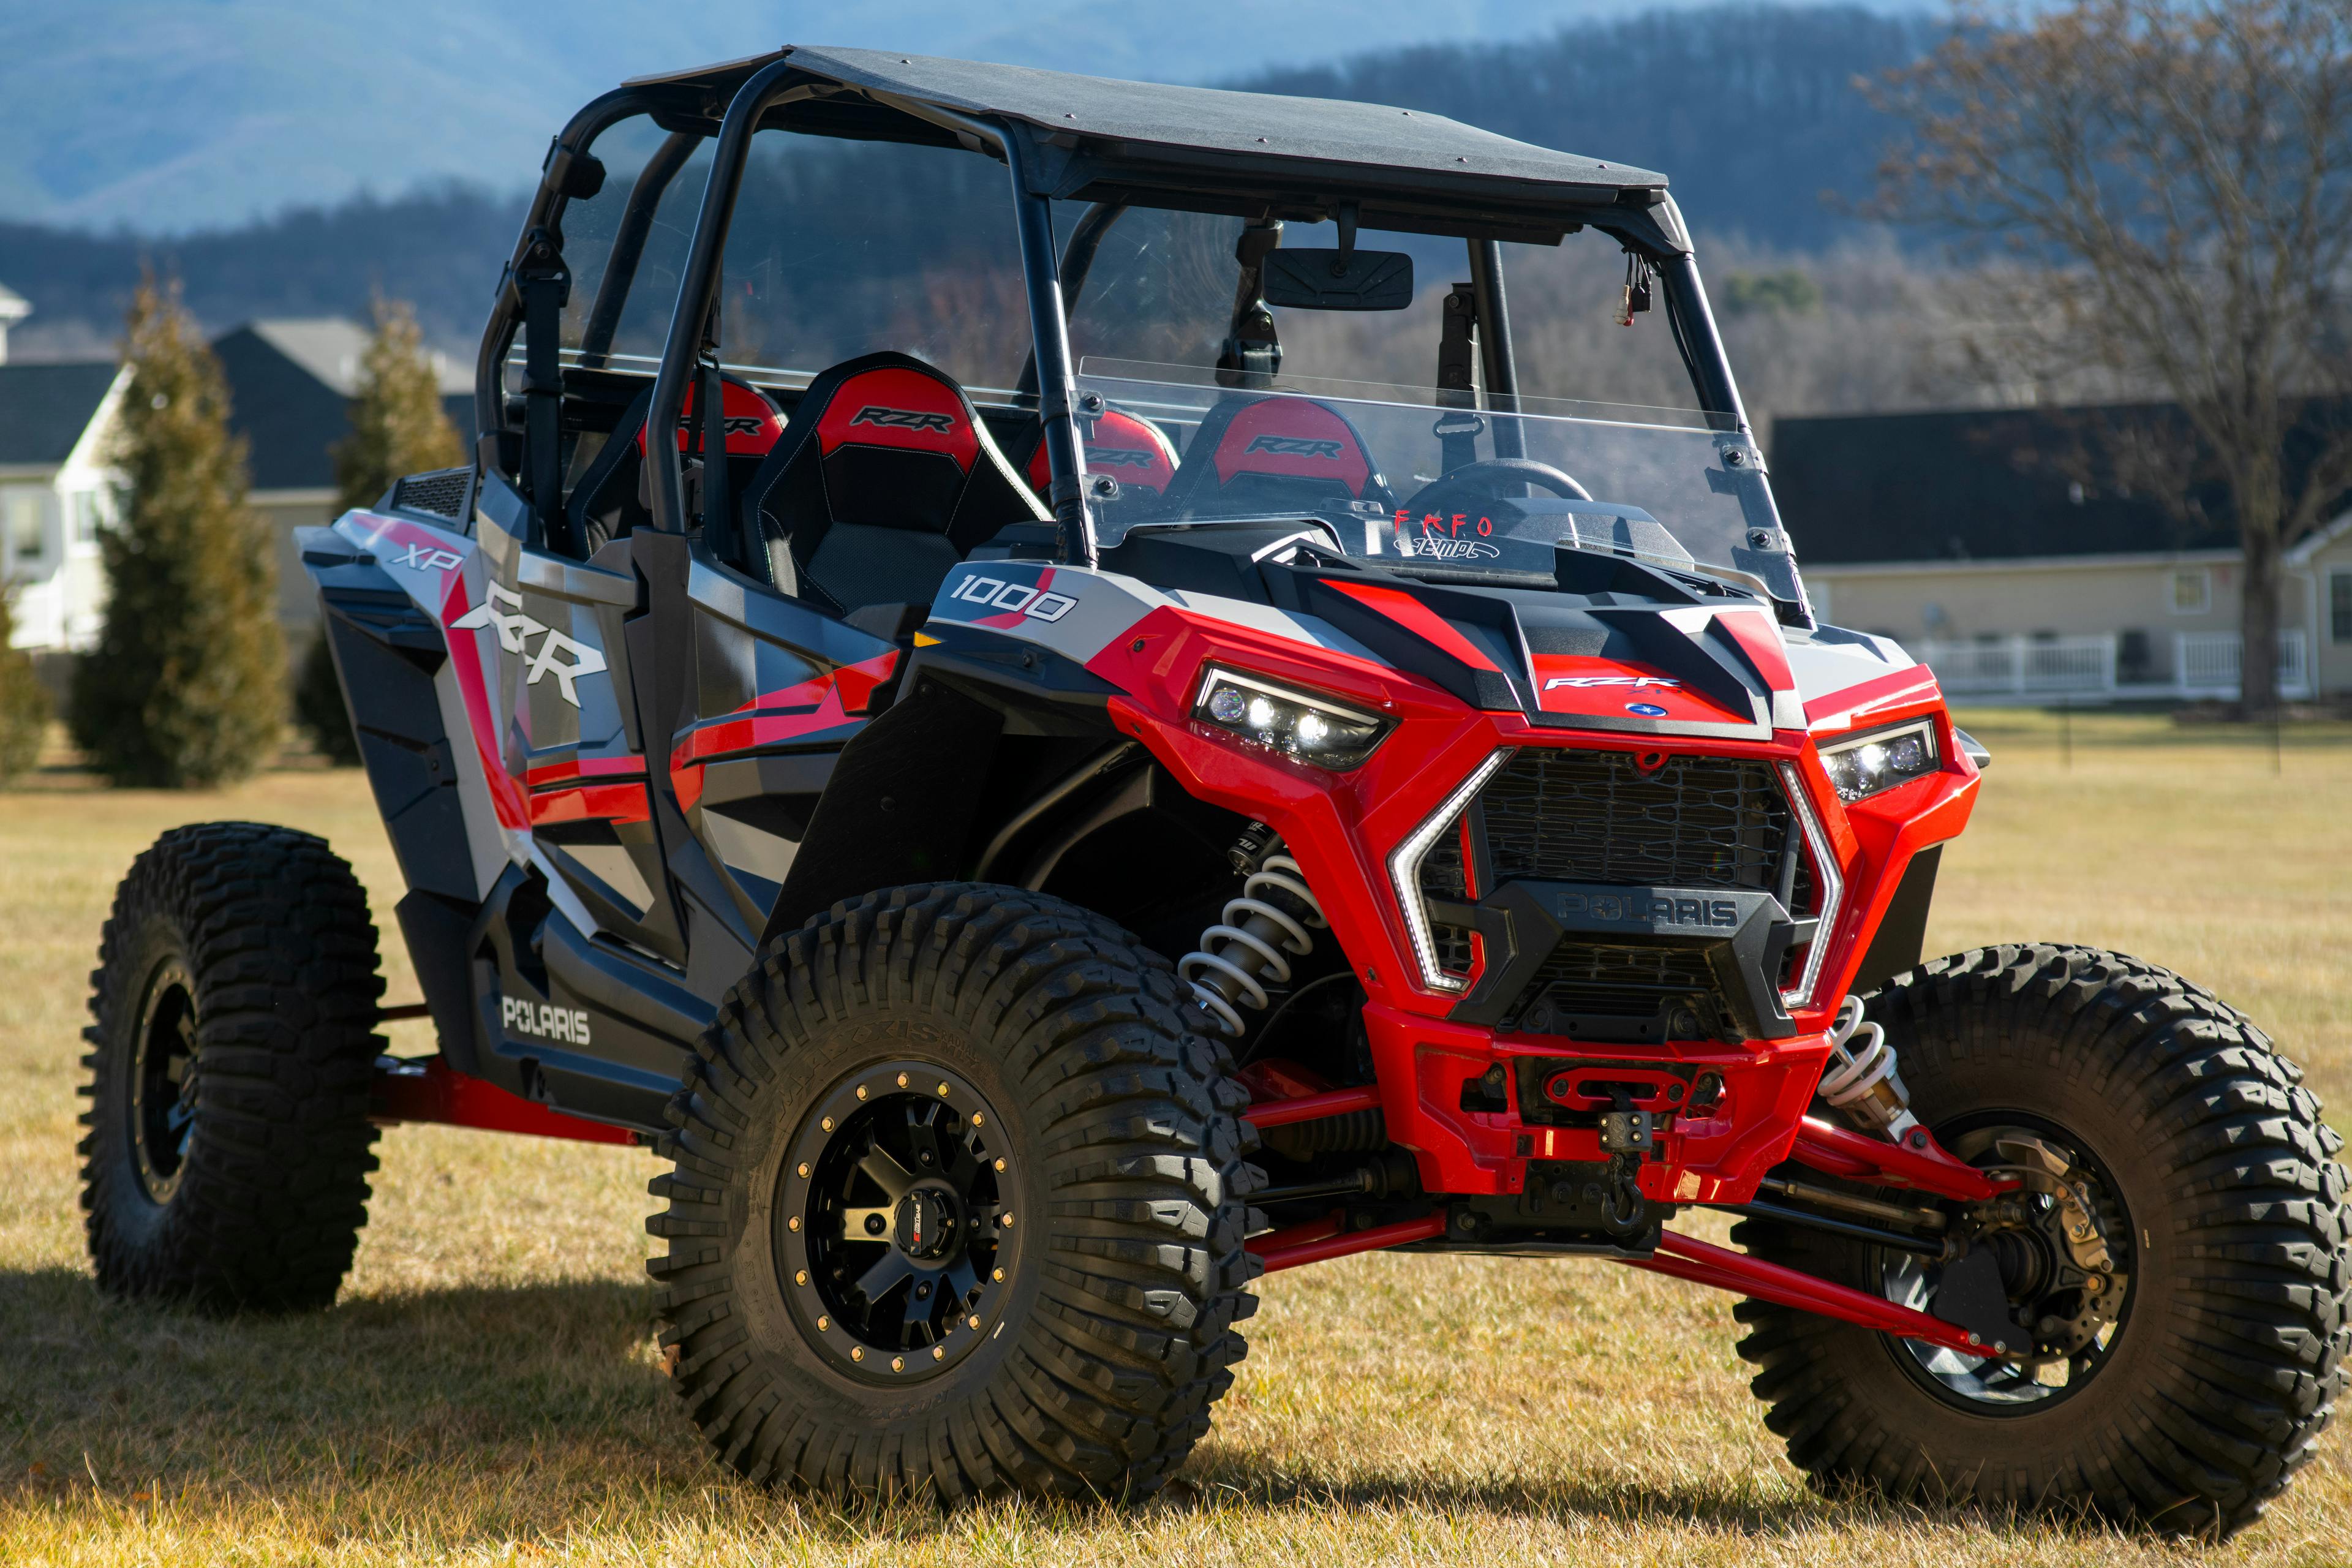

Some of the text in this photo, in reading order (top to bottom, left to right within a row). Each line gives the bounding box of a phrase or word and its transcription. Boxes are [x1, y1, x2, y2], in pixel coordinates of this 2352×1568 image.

[849, 405, 956, 435] RZR
[1243, 434, 1345, 461] RZR
[390, 542, 466, 572] XP
[950, 574, 1079, 624] 1000
[1542, 677, 1683, 692] RZR
[1557, 892, 1738, 928] POLARIS
[502, 995, 590, 1046] POLARIS
